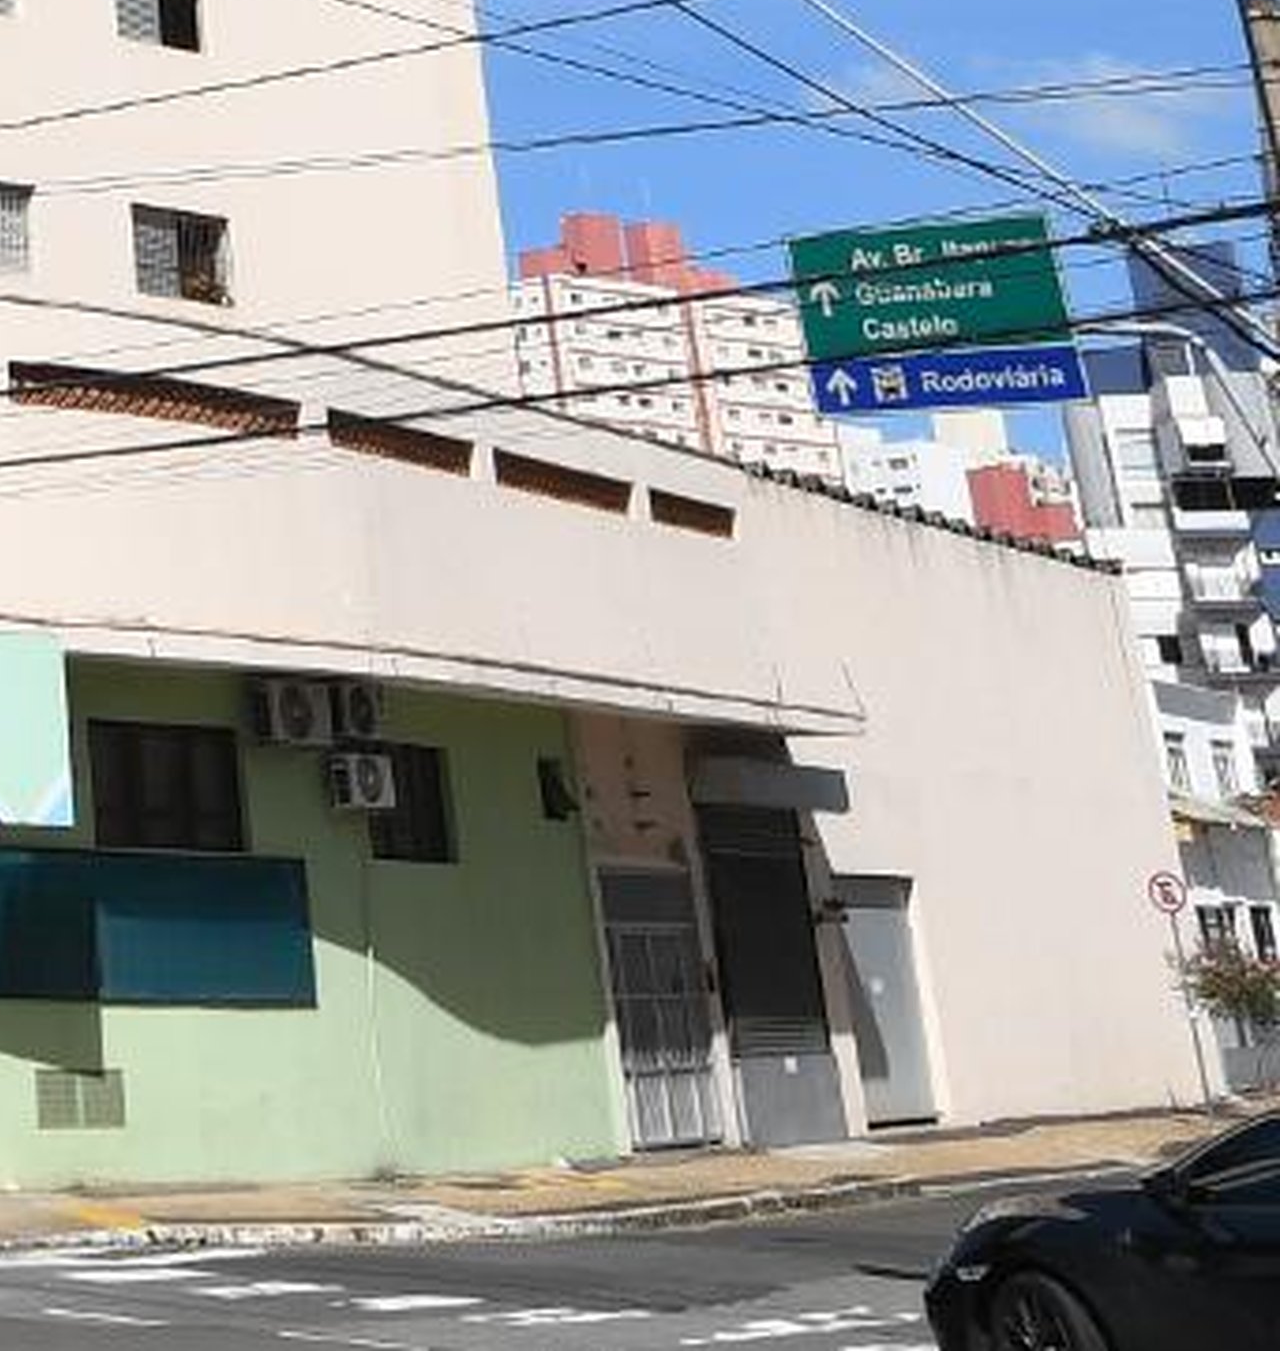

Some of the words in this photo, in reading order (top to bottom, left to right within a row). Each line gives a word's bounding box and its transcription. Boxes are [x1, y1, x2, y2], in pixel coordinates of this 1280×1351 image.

[851, 247, 887, 271] Av.
[861, 315, 959, 341] Castelo
[920, 361, 1067, 393] Rodoviária
